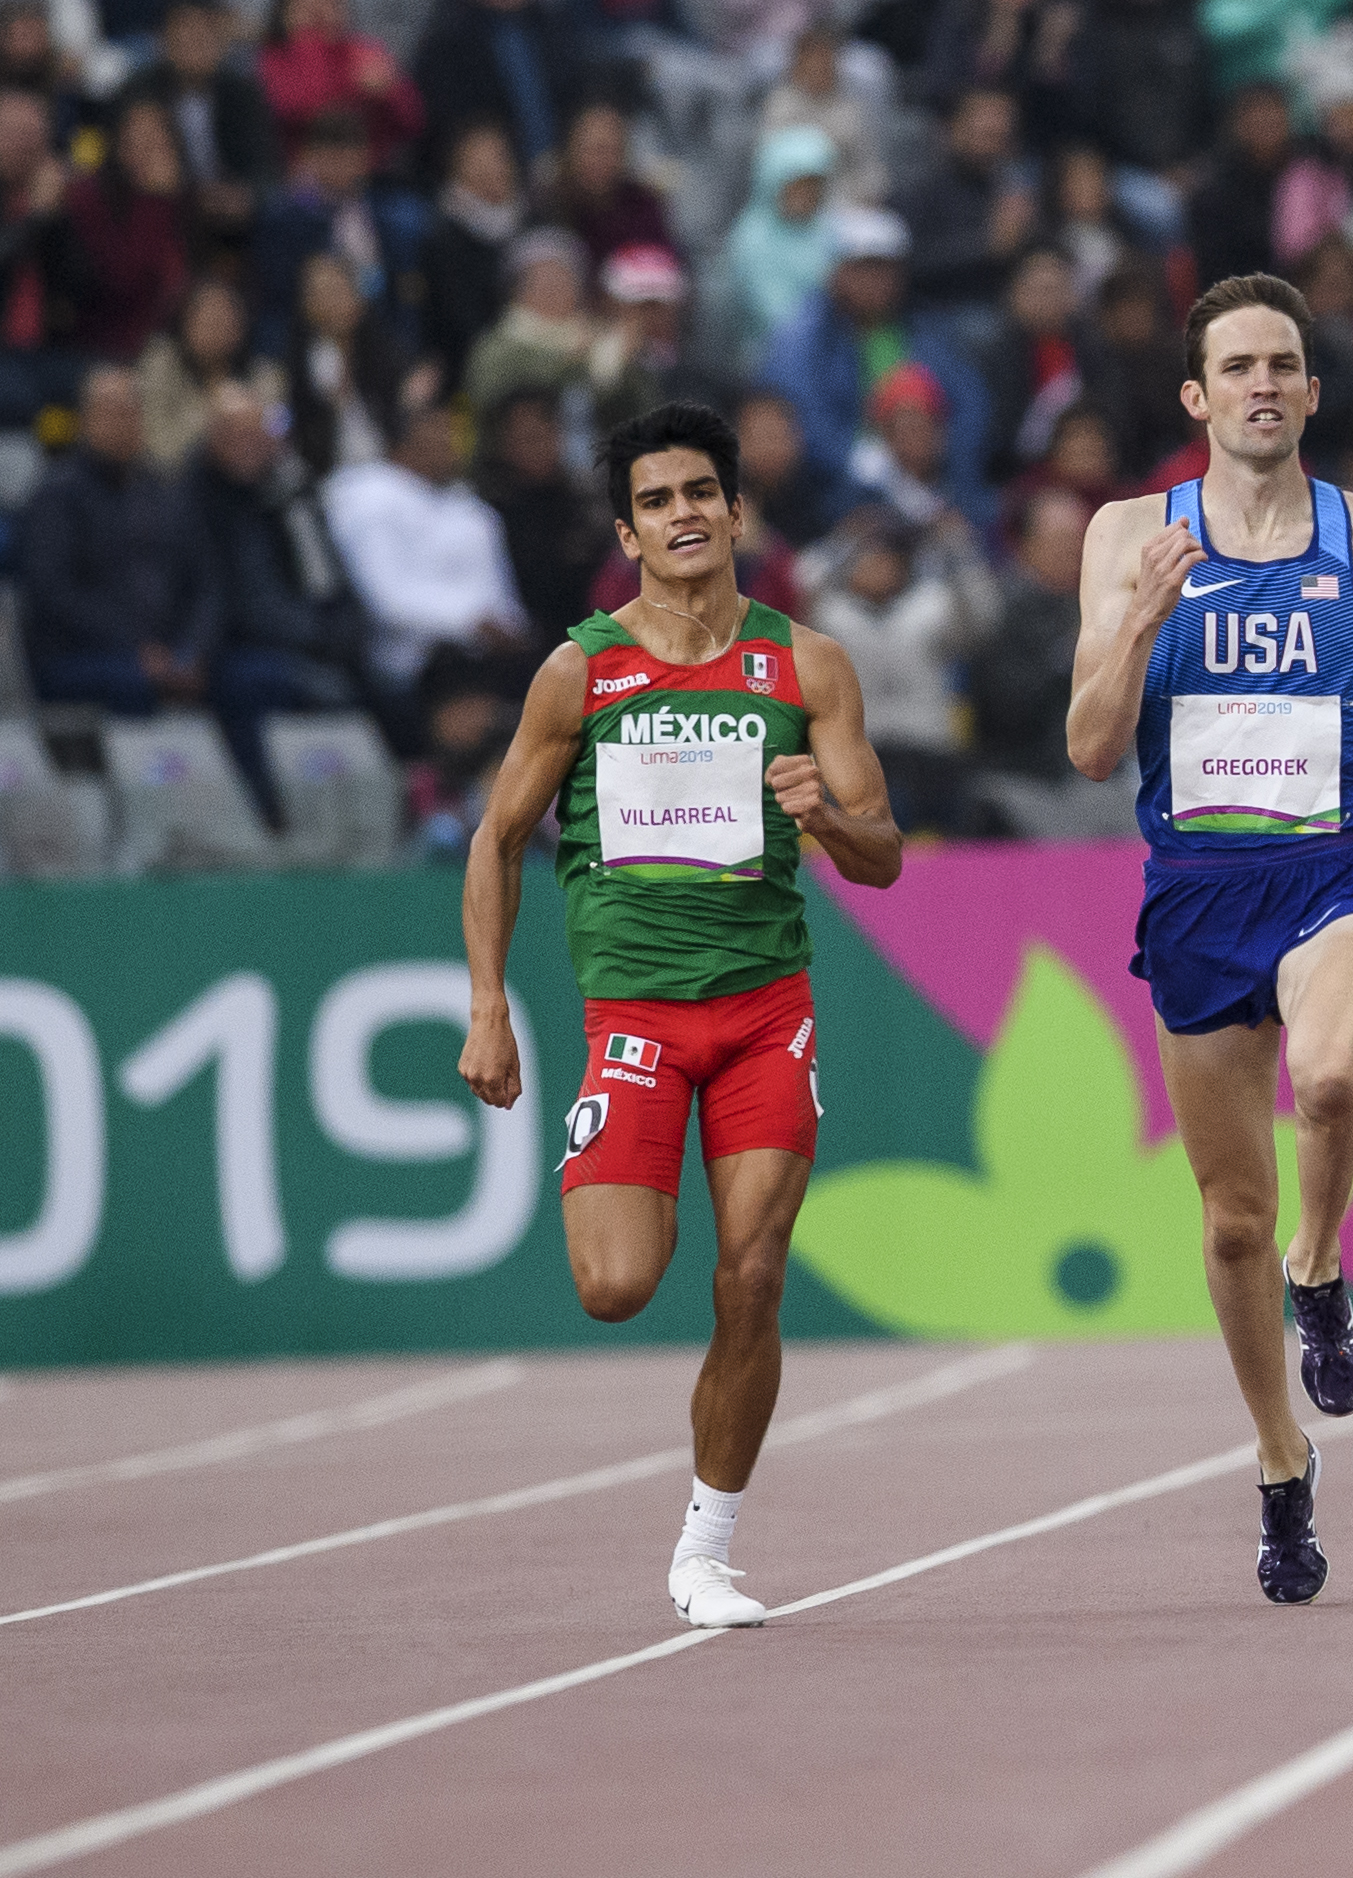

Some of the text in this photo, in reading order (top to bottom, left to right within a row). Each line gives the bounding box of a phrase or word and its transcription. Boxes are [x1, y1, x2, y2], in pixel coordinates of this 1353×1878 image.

[1204, 611, 1318, 674] USA
[593, 672, 651, 695] Joma
[620, 706, 767, 745] MÉXICO
[1202, 759, 1308, 775] GREGOREK
[620, 806, 737, 825] VILLARREAL
[601, 1067, 657, 1089] MÉXICO
